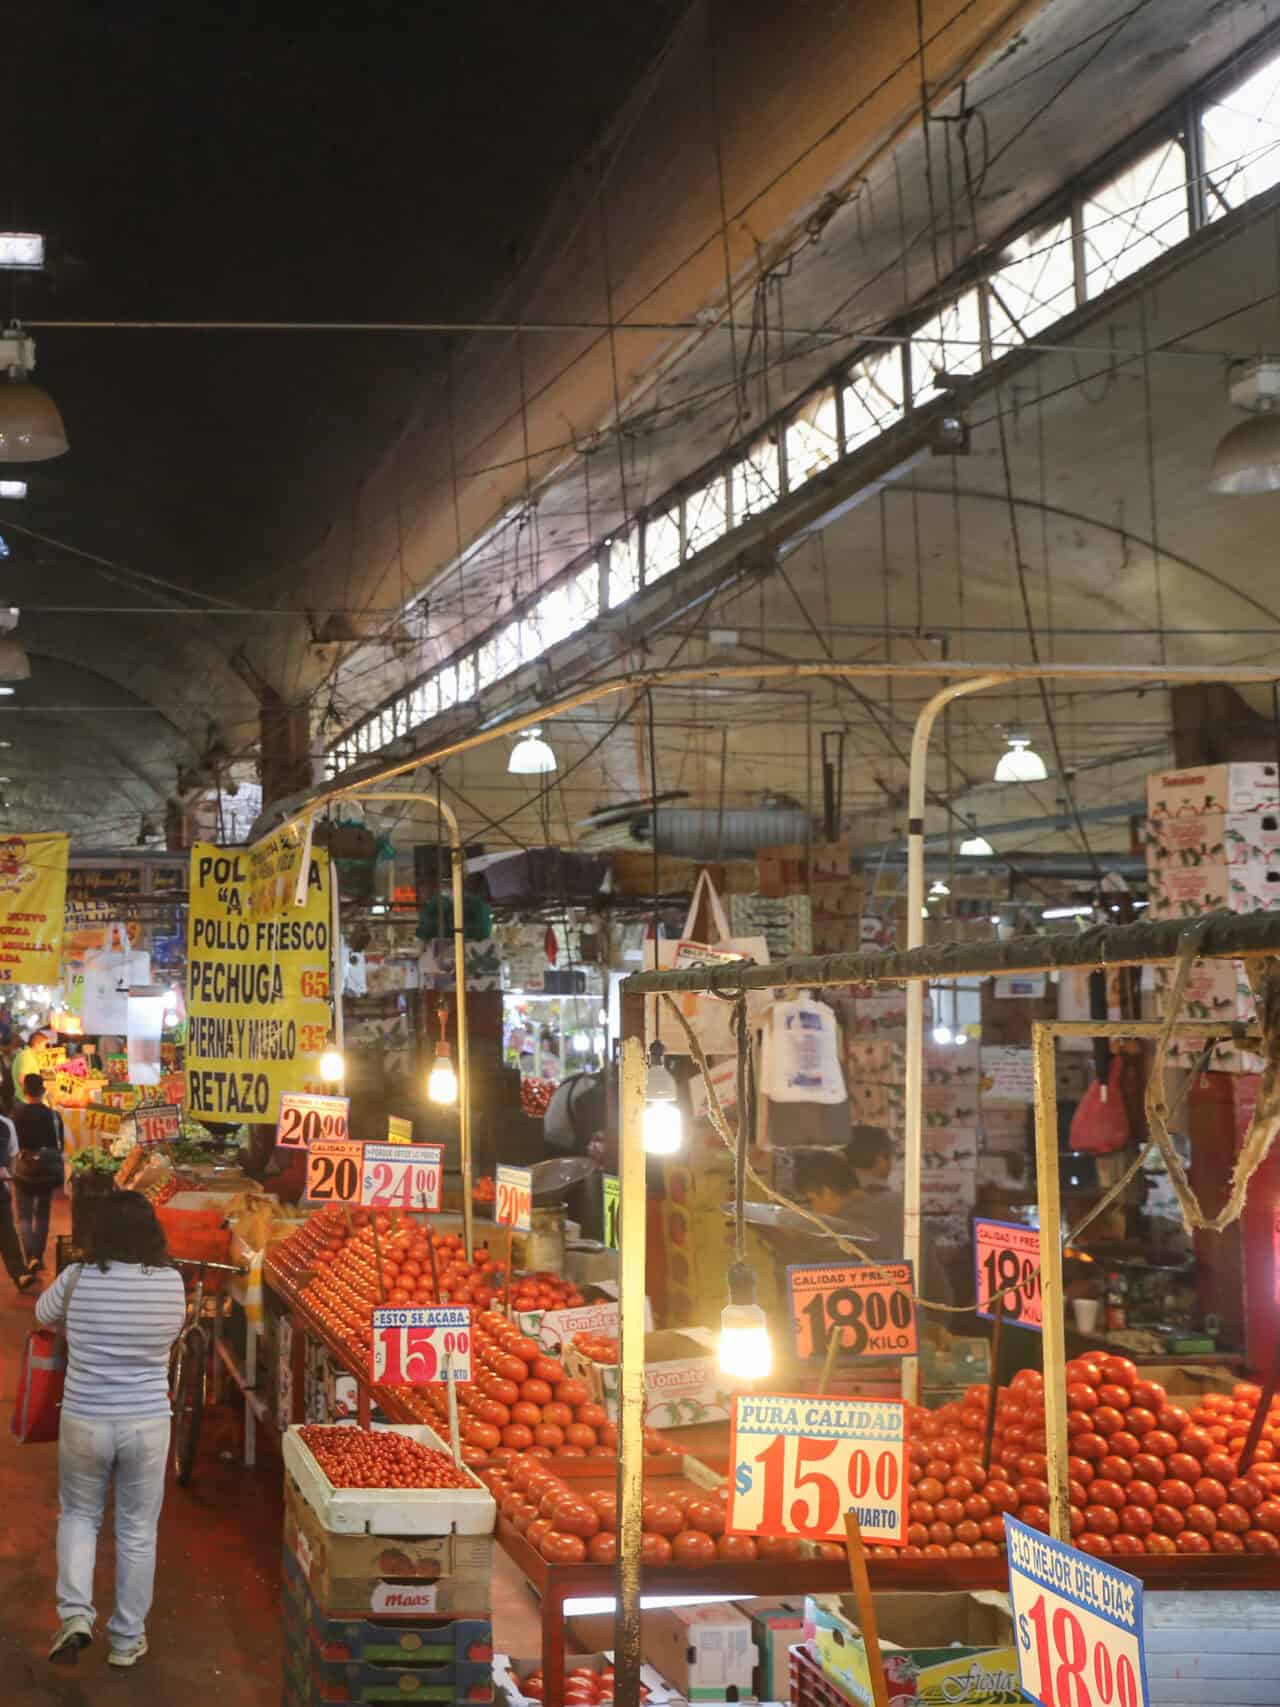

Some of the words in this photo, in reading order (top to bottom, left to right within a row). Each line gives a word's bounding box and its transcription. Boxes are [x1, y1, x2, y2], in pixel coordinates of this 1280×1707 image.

[193, 918, 250, 951] POLLO
[255, 920, 328, 952] FRESCO
[190, 960, 284, 1005] PECHUGA
[300, 971, 329, 999] 65
[189, 1015, 235, 1059] PIERNA
[236, 1018, 246, 1061] Y
[189, 1070, 271, 1115] RETAZO
[310, 1156, 358, 1201] 20
[978, 1228, 1010, 1242] CALIDAD
[793, 1272, 846, 1286] CALIDAD
[849, 1272, 859, 1281] Y
[380, 1312, 408, 1324] ESTO
[411, 1312, 425, 1324] SE
[428, 1312, 465, 1323] ACABA
[869, 1335, 910, 1351] KILO
[741, 1404, 799, 1426] PURA
[805, 1408, 902, 1432] CALIDAD
[1019, 1545, 1032, 1566] LO
[1033, 1548, 1071, 1588] MEJOR
[1074, 1566, 1099, 1601] DEL
[1102, 1579, 1125, 1613] DIA
[941, 1662, 1017, 1704] Fiesta
